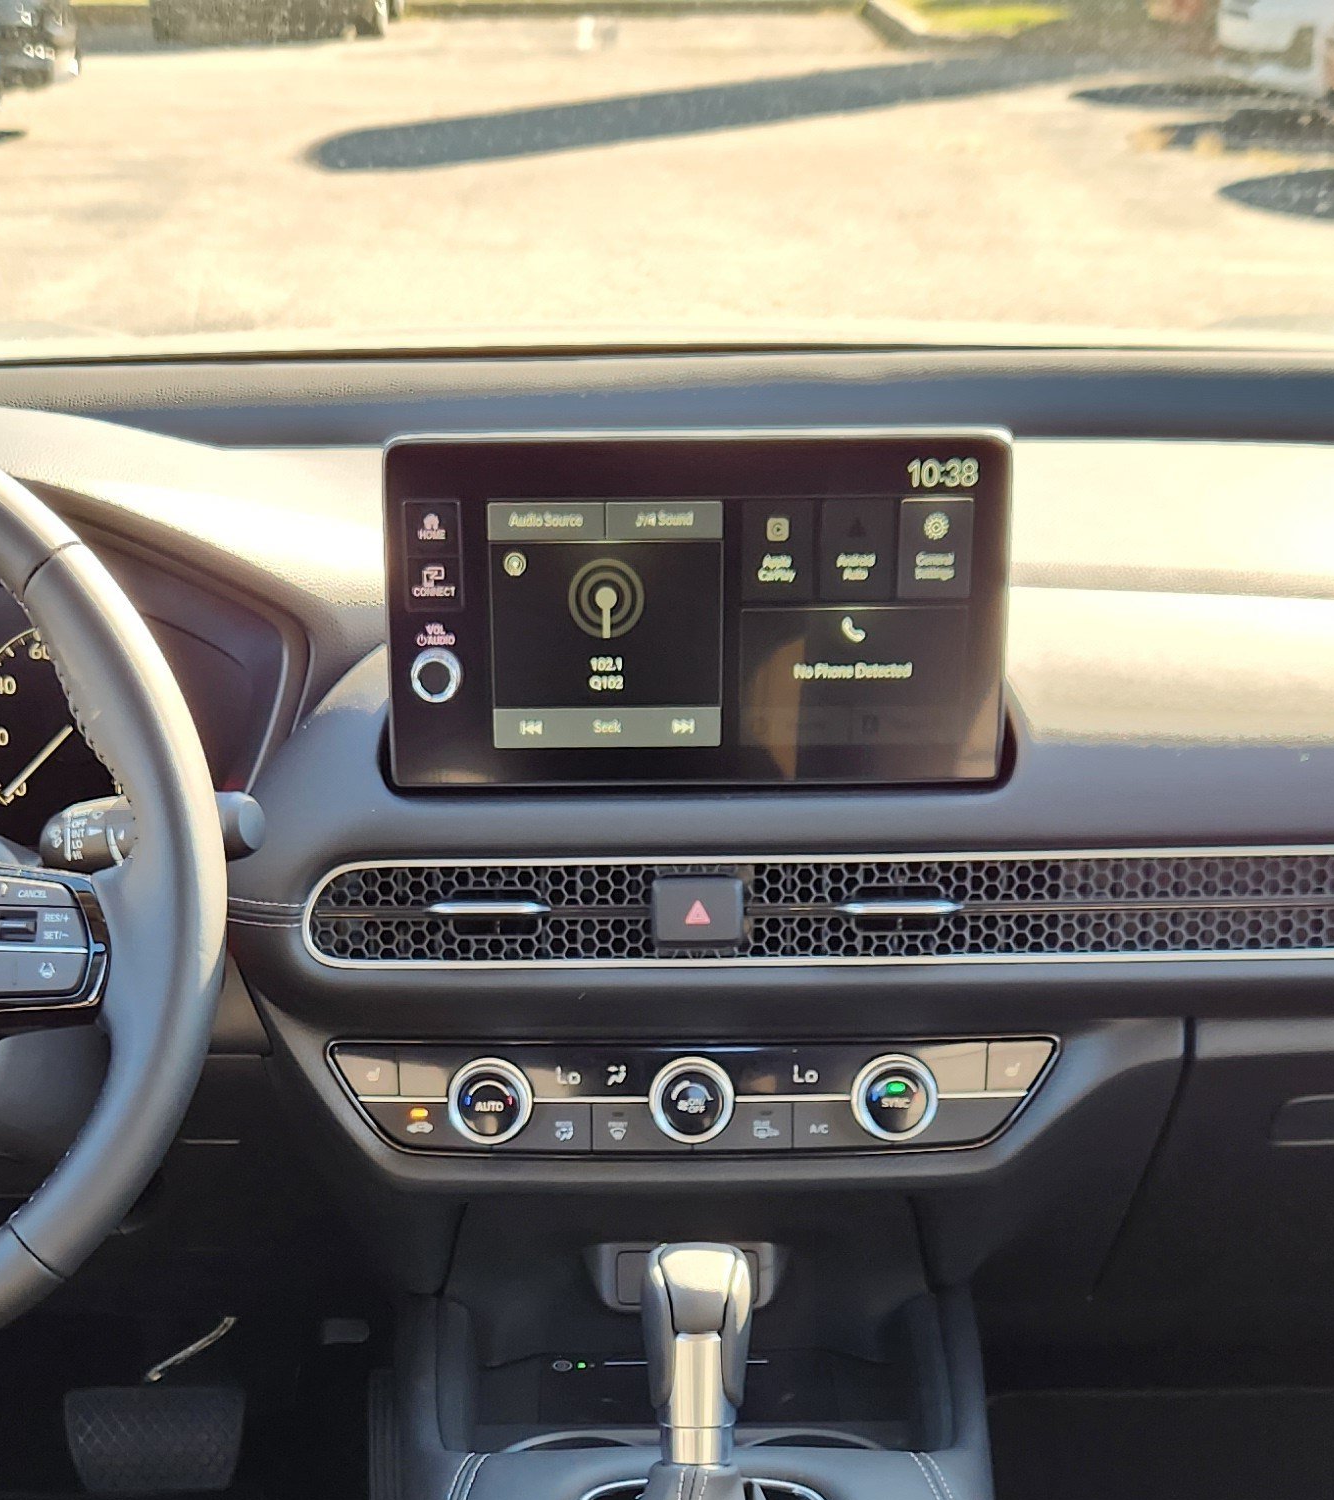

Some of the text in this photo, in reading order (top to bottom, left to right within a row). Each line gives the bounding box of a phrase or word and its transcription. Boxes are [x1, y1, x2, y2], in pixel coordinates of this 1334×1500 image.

[907, 457, 979, 488] 10:38
[509, 510, 584, 527] Audio Source
[658, 510, 695, 527] Sound
[417, 528, 446, 540] HOME
[412, 586, 456, 597] CONNECT
[425, 624, 446, 635] VOL
[427, 634, 456, 646] AUDIO
[589, 656, 624, 672] 102.1
[793, 661, 913, 680] No Phone Detected
[589, 675, 624, 691] Q102
[592, 719, 622, 734] Seek
[71, 839, 84, 850] LO
[18, 889, 48, 899] CANCEL
[43, 912, 70, 923] RES/+
[555, 1065, 581, 1085] Lo
[792, 1064, 819, 1084] Lo
[474, 1101, 504, 1113] AUTO
[881, 1097, 910, 1109] SYNC
[809, 1123, 829, 1135] A/C
